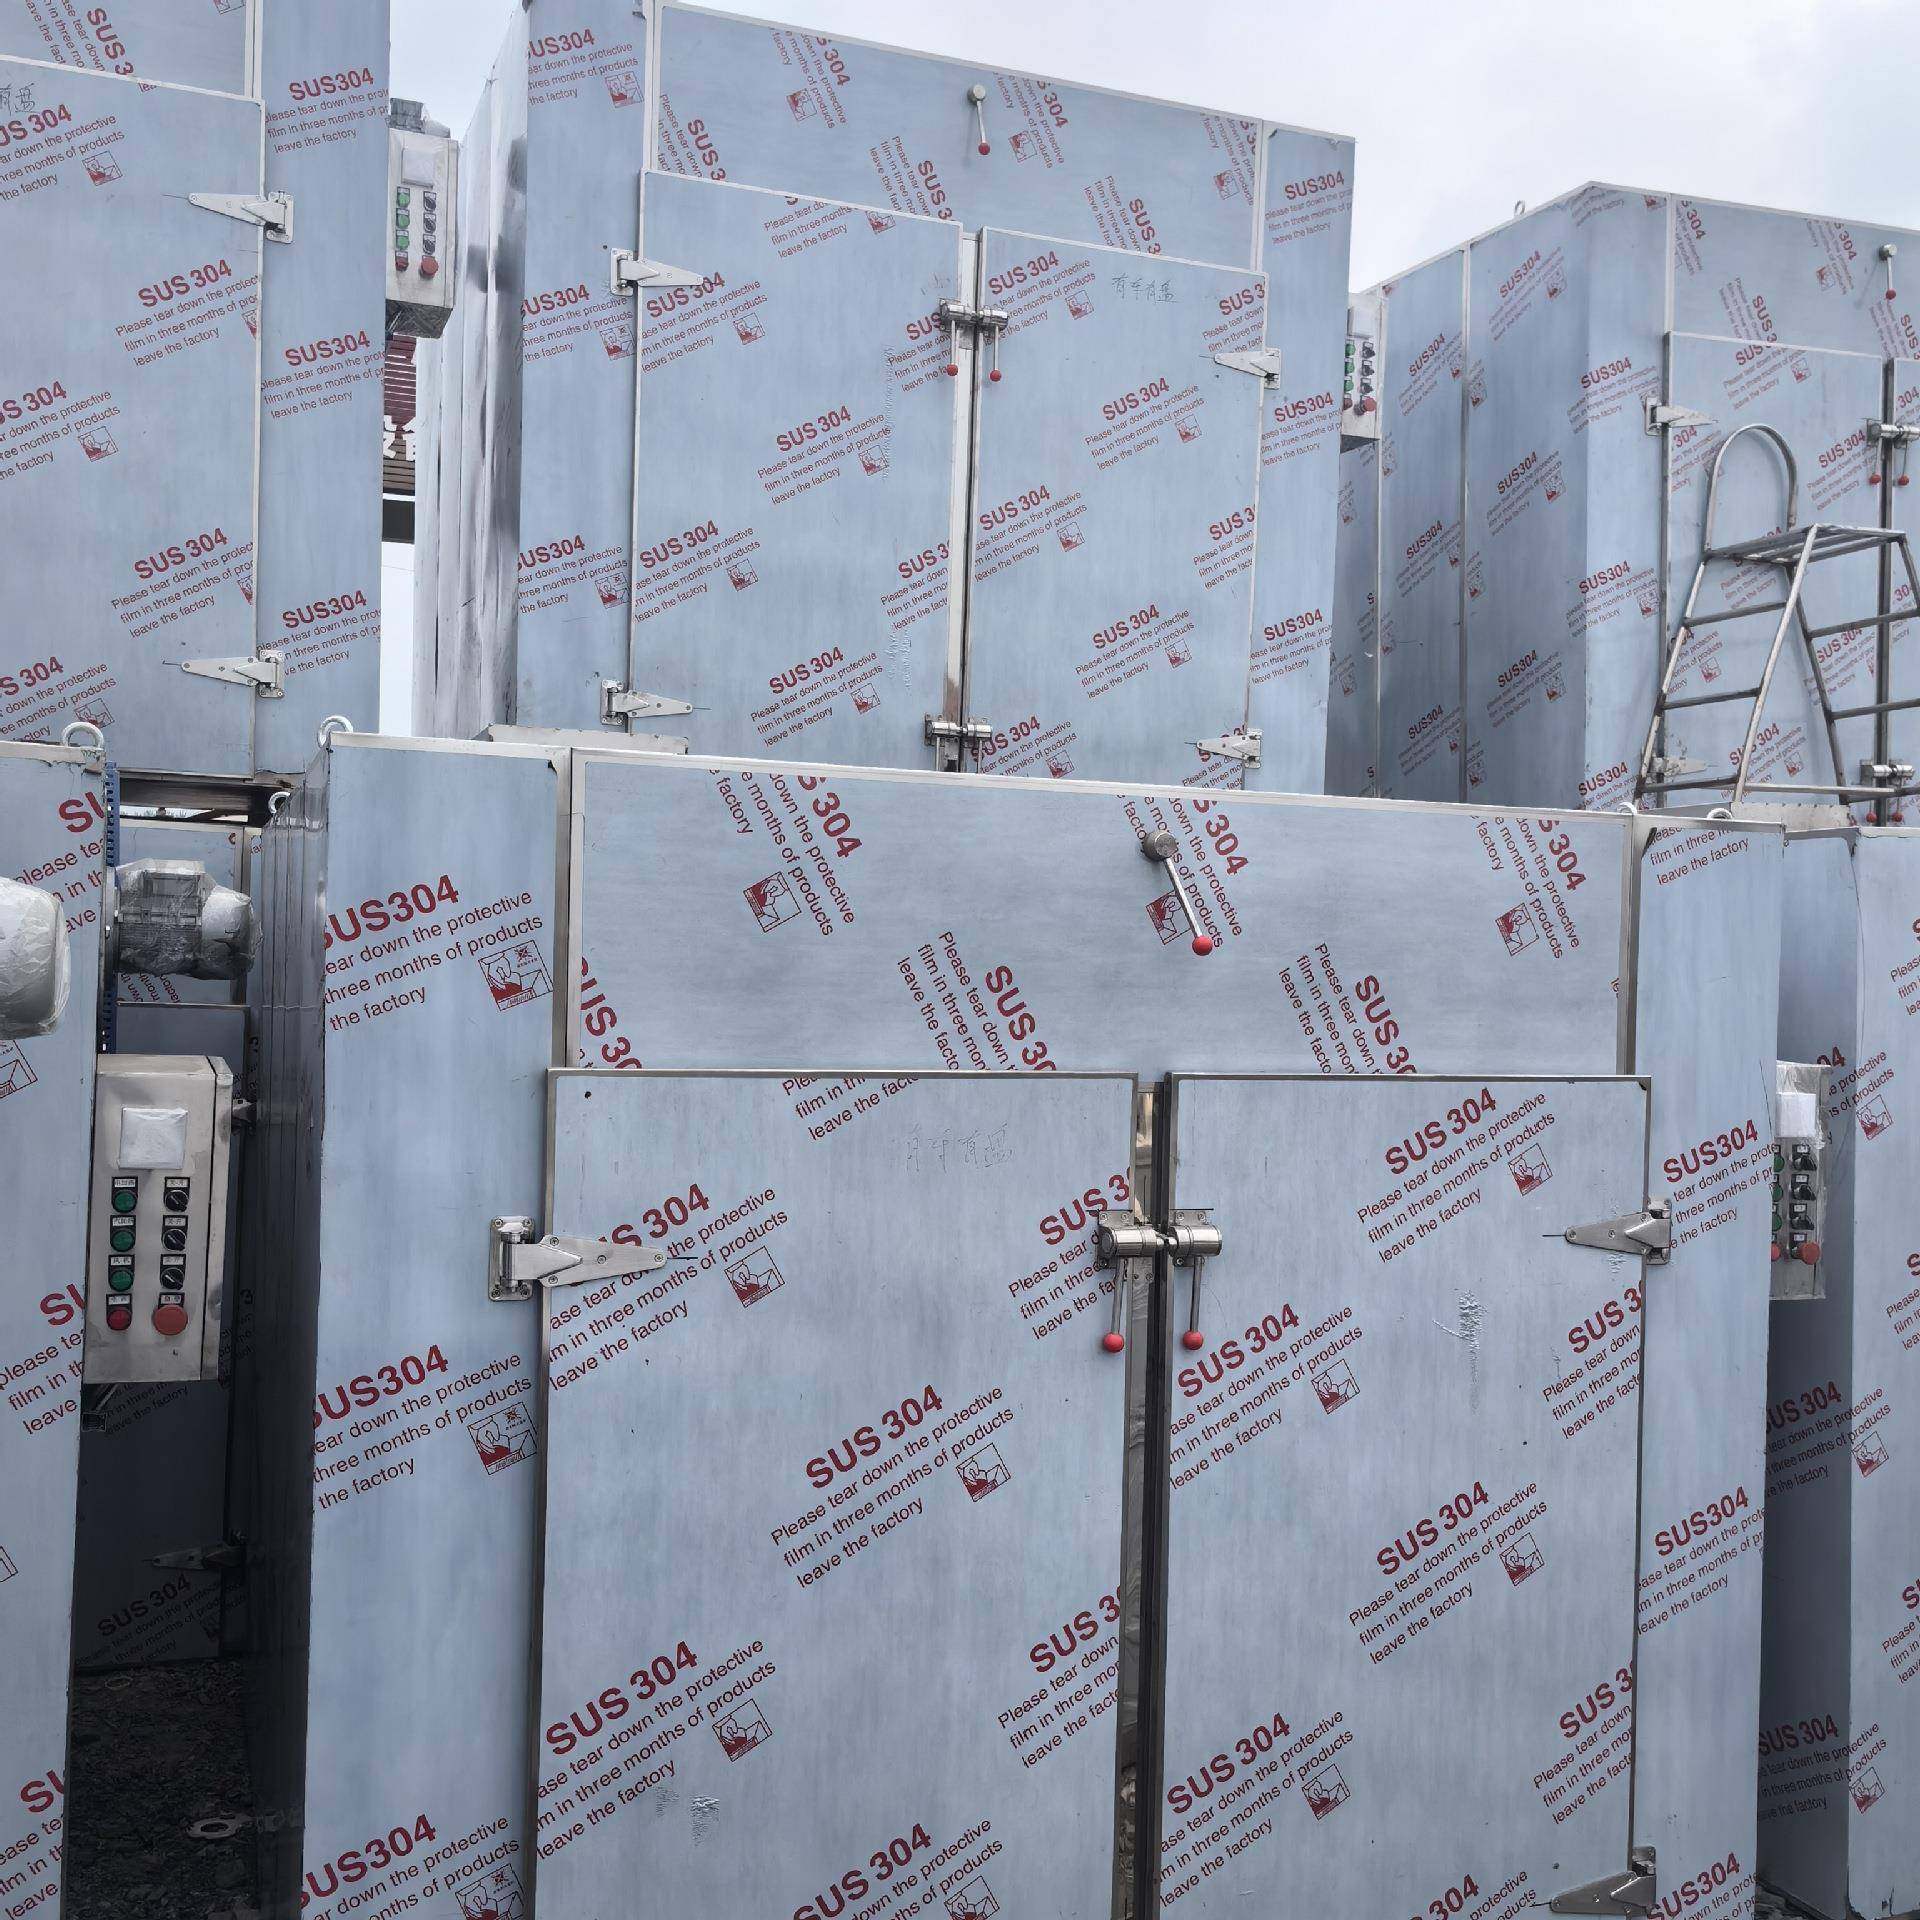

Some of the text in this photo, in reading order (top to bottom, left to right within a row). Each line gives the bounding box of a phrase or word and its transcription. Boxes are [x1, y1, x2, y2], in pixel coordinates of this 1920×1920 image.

[528, 28, 595, 59] US304
[289, 68, 374, 101] SUS304
[1285, 170, 1345, 200] SUS304
[114, 288, 224, 337] Please tear down the
[124, 299, 238, 352] film in three months of
[521, 284, 590, 316] US304
[132, 327, 220, 369] leave the factory
[285, 330, 371, 366] SUS304
[1580, 356, 1632, 389] SUS304
[1274, 391, 1334, 422] SUS304
[757, 414, 885, 479] Please tear down the protective
[764, 424, 892, 493] film in three months of products
[771, 467, 841, 506] leave the factory
[535, 546, 622, 579] down the protective
[578, 570, 588, 580] of
[589, 560, 628, 579] products
[1579, 560, 1631, 595] SUS304
[520, 593, 569, 614] the factory
[1263, 608, 1323, 641] SUS304
[716, 776, 754, 834] factory
[1578, 762, 1628, 797] SUS304
[812, 791, 863, 858] 304
[747, 782, 834, 936] months of products
[792, 814, 855, 924] the protective
[1548, 833, 1587, 891] 304
[322, 892, 533, 978] ear down the protective
[324, 979, 371, 1008] three
[374, 953, 442, 987] months
[445, 941, 463, 960] of
[466, 916, 543, 957] products
[329, 986, 425, 1031] the factory
[1354, 974, 1400, 1046] SUS
[1356, 1093, 1547, 1225] Please tear down the protective
[1664, 1119, 1758, 1183] SUS304
[1368, 1113, 1555, 1244] film in three months of products
[1378, 1187, 1481, 1264] leave the factory
[8, 1372, 67, 1411] film in
[23, 1399, 78, 1435] leave
[1816, 1418, 1833, 1433] the
[1833, 1387, 1883, 1429] protective
[1798, 1404, 1891, 1462] months of products
[770, 1388, 1003, 1547] Please tear down the protective
[783, 1408, 1014, 1568] film in three months of products
[1778, 1465, 1829, 1494] the factory
[796, 1497, 923, 1589] leave the factory
[1655, 1486, 1748, 1556] SUS304
[1348, 1482, 1537, 1627] Please tear down the protective
[1359, 1501, 1548, 1647] film in three months of products
[1369, 1581, 1473, 1665] leave the factory
[1881, 1621, 1915, 1653] Please
[1889, 1640, 1920, 1669] film in
